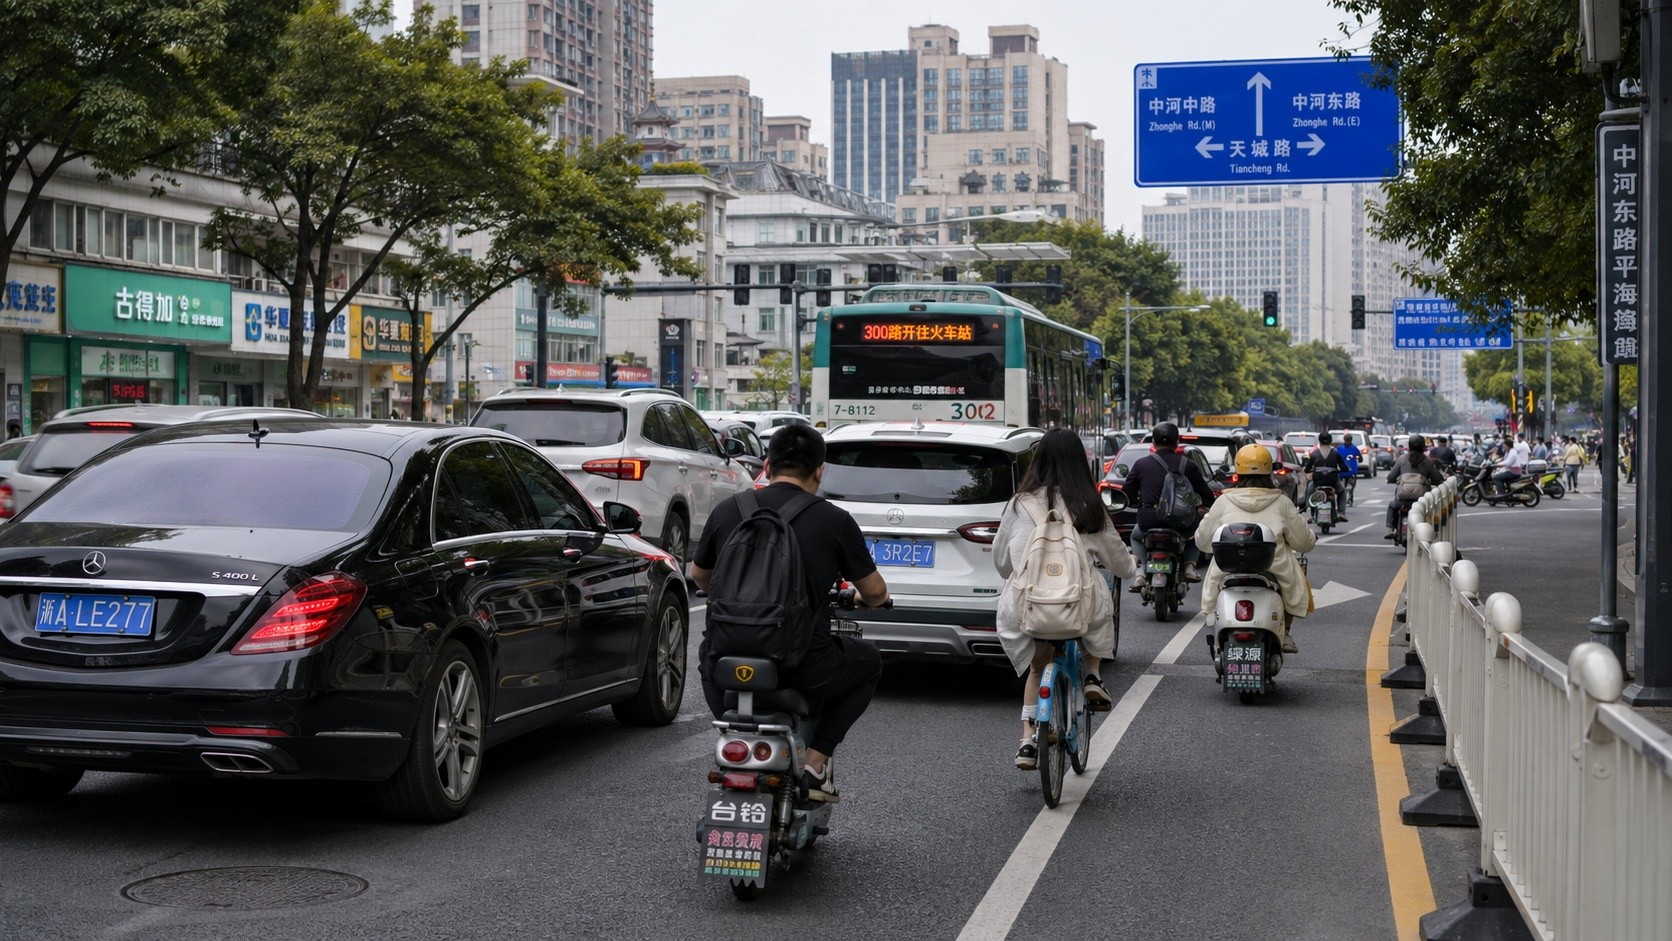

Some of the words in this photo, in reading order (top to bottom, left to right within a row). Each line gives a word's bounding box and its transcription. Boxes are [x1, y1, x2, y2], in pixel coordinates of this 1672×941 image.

[1149, 97, 1216, 115] 中河中路
[1293, 92, 1361, 111] 中河东路
[1149, 121, 1183, 132] Zhonghe
[1188, 120, 1216, 131] Rd.(M)
[1293, 117, 1328, 129] Zhonghe
[1332, 116, 1361, 128] Rd.(E)
[1229, 139, 1291, 158] 天城路
[1230, 164, 1272, 175] Tiancheng
[1276, 163, 1290, 174] Rd.
[115, 286, 173, 323] 古得加
[834, 404, 876, 416] 7-8112
[711, 800, 767, 824] 台铃
